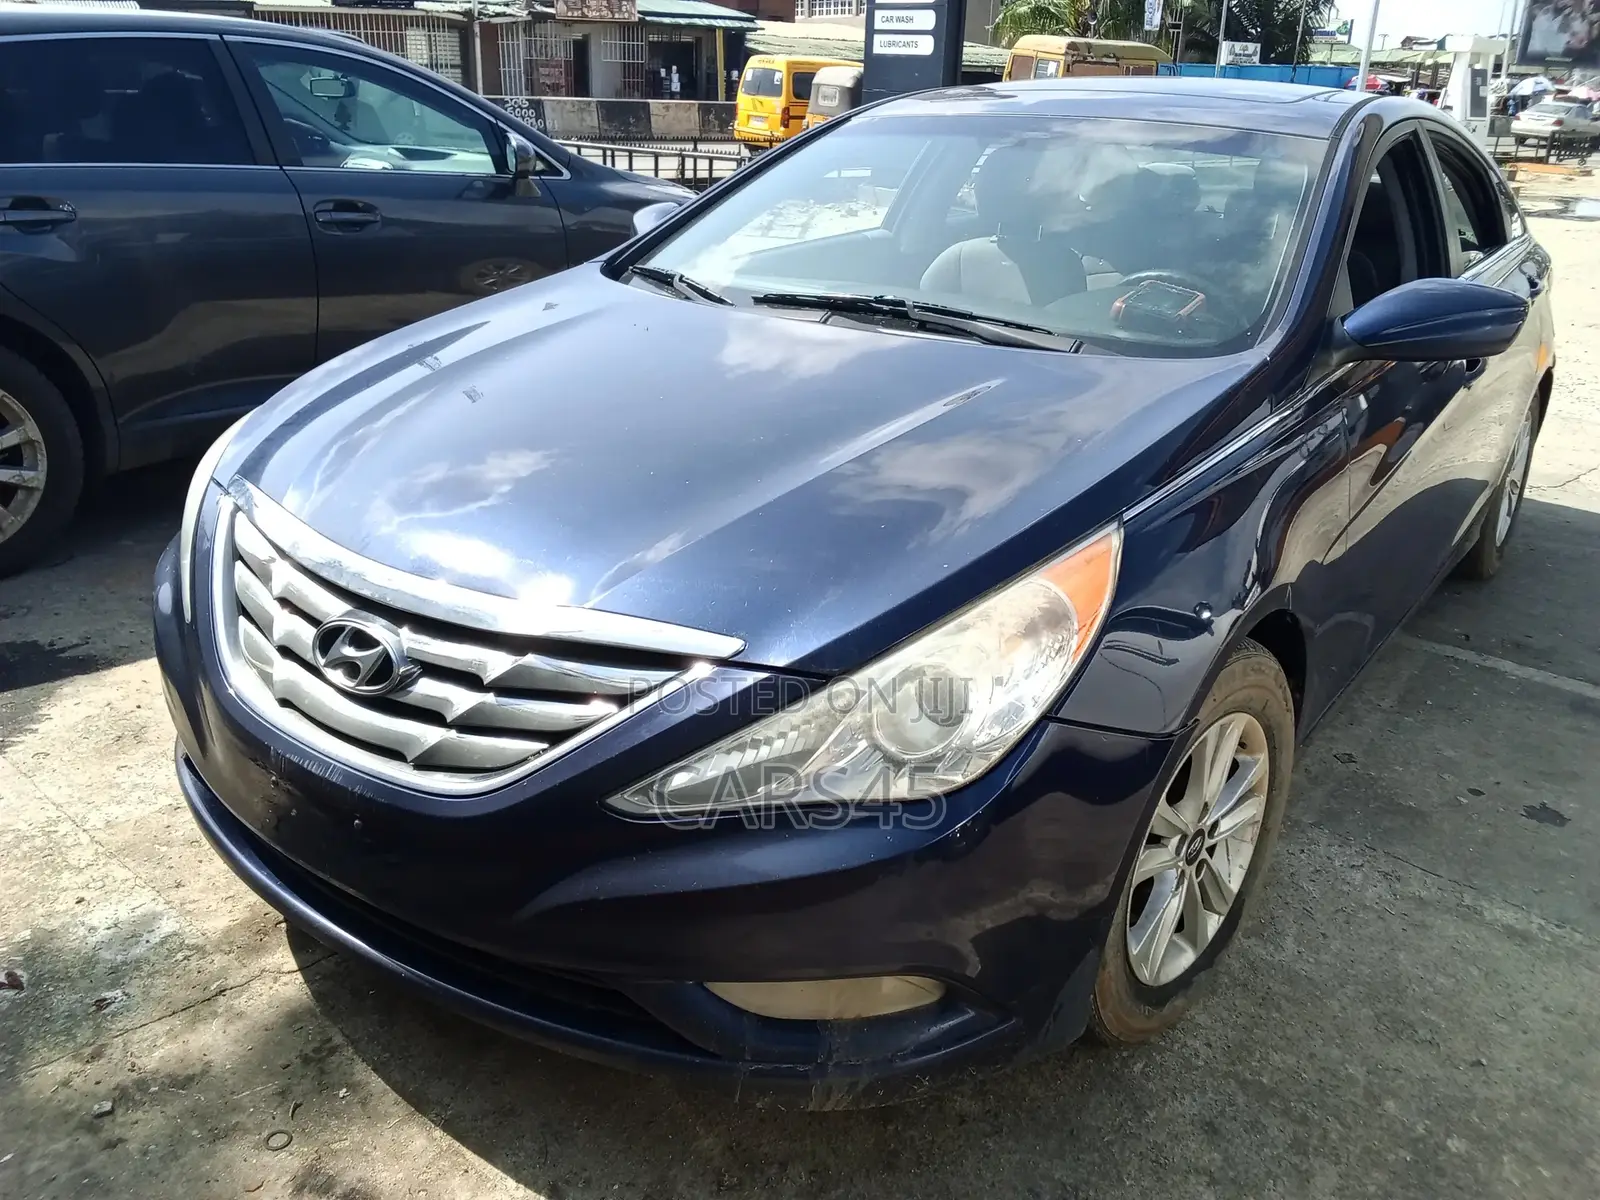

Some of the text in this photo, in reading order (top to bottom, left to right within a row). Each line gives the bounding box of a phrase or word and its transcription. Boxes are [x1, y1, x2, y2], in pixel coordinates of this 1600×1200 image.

[881, 15, 914, 23] CAR WASH
[879, 40, 919, 48] LUBRICANTS
